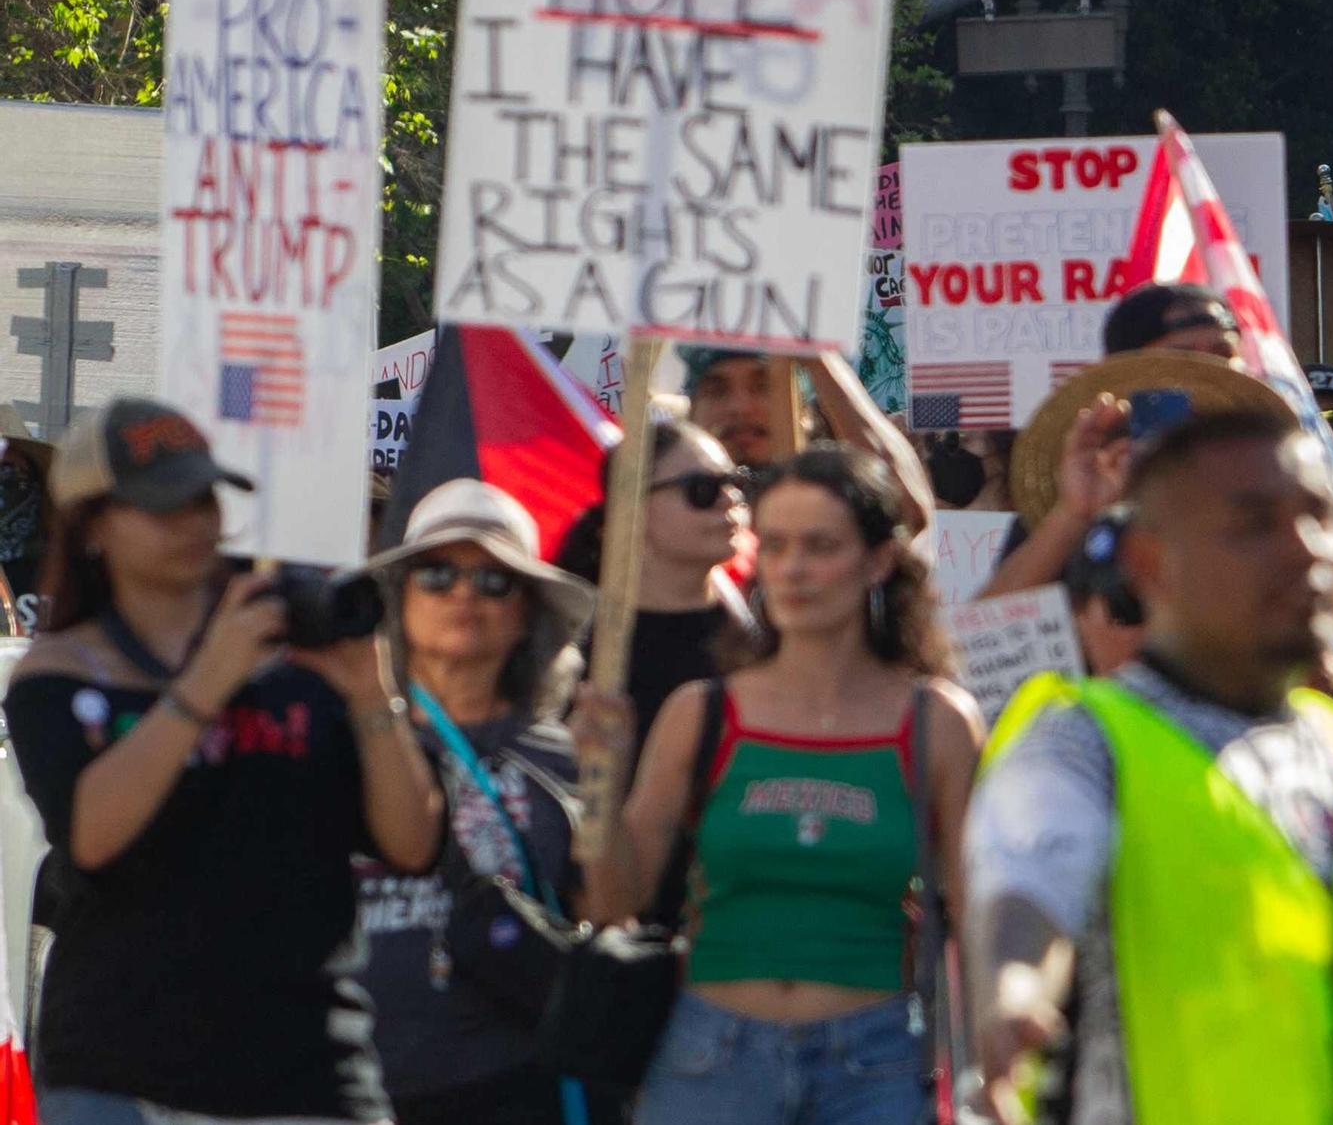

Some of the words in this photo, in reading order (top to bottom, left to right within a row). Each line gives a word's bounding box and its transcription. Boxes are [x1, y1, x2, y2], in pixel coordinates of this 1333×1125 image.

[168, 57, 370, 154] AMERICA
[463, 17, 532, 102] I
[568, 25, 754, 113] HAVE
[194, 138, 357, 220] ANTI-
[496, 109, 654, 193] THE
[678, 109, 870, 217] SAME
[1007, 146, 1138, 192] STOP
[172, 207, 359, 311] TRUMP
[470, 180, 762, 275] RIGHTS
[449, 254, 543, 316] AS
[569, 258, 622, 321] A
[637, 268, 823, 346] GUN
[907, 259, 1045, 307] YOUR
